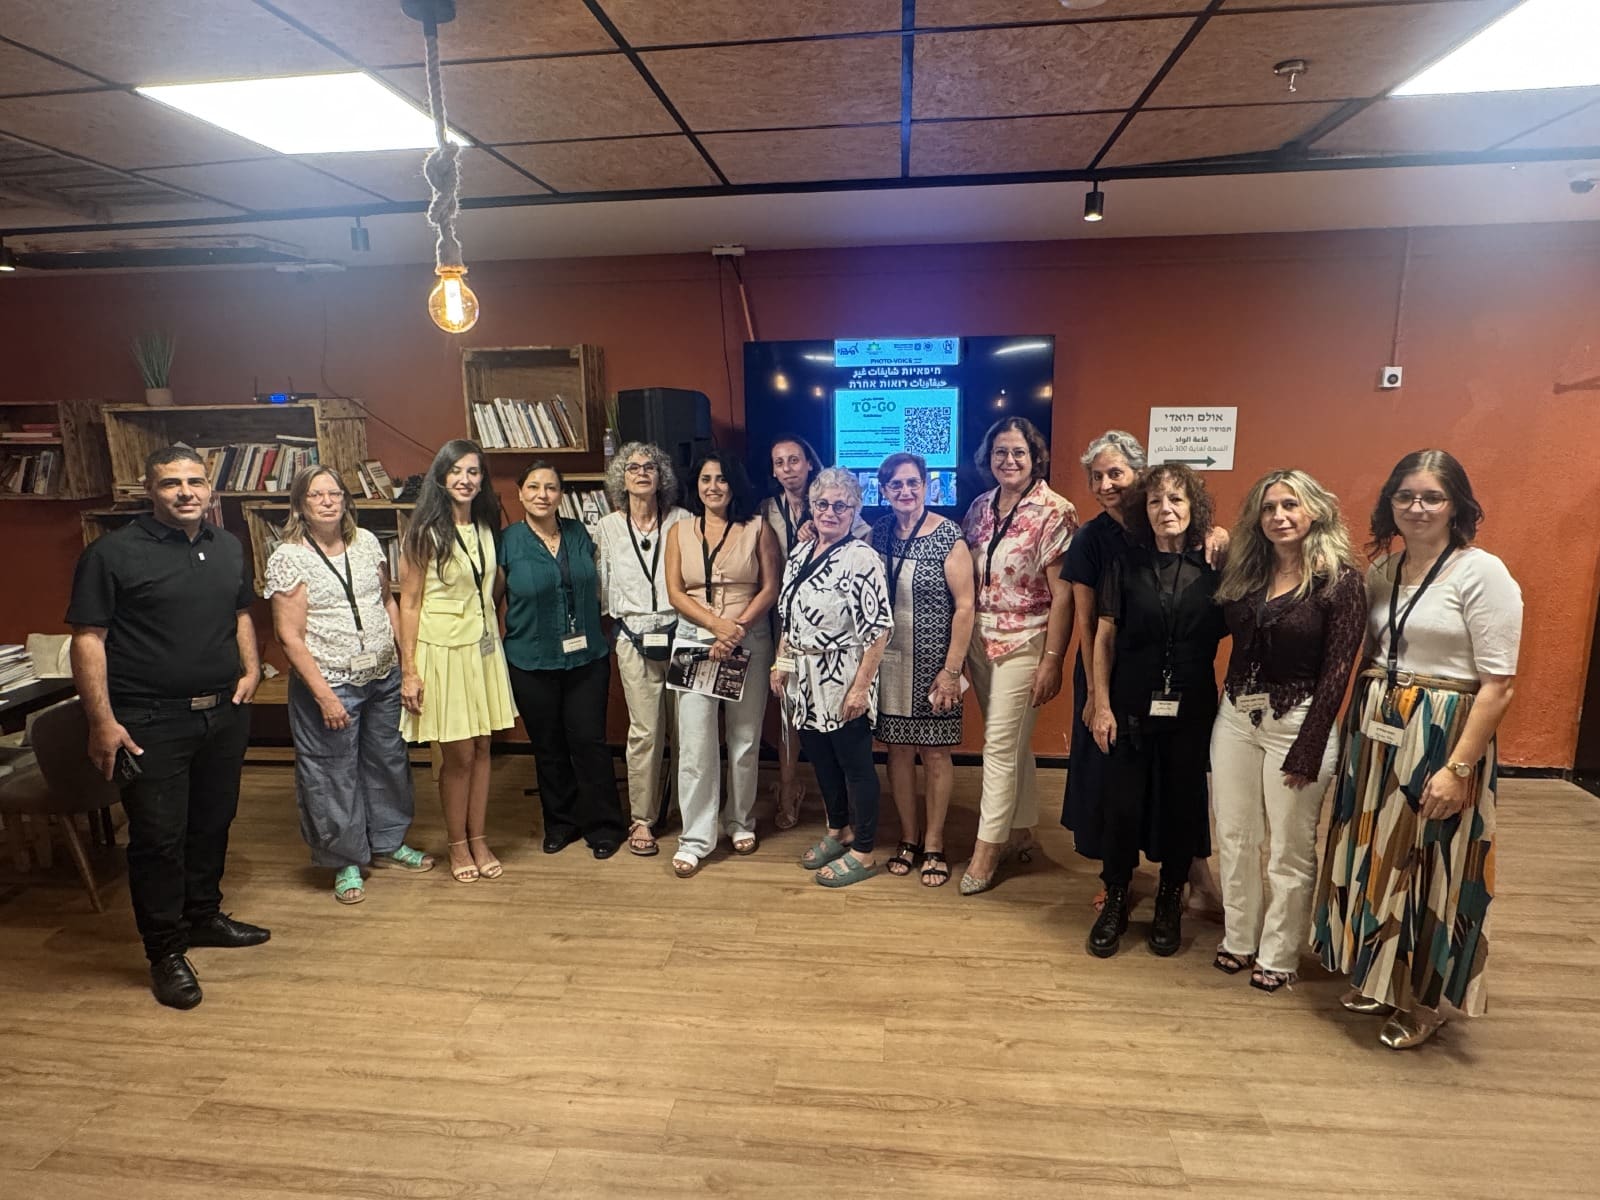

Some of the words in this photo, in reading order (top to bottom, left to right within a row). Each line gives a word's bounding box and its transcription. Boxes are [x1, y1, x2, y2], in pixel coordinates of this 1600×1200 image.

[902, 367, 941, 376] חיפאיות
[849, 380, 876, 388] אחרת
[880, 380, 907, 388] רואות
[852, 401, 896, 412] TO-GO
[1165, 413, 1194, 422] הואדי
[1197, 412, 1223, 422] אולם
